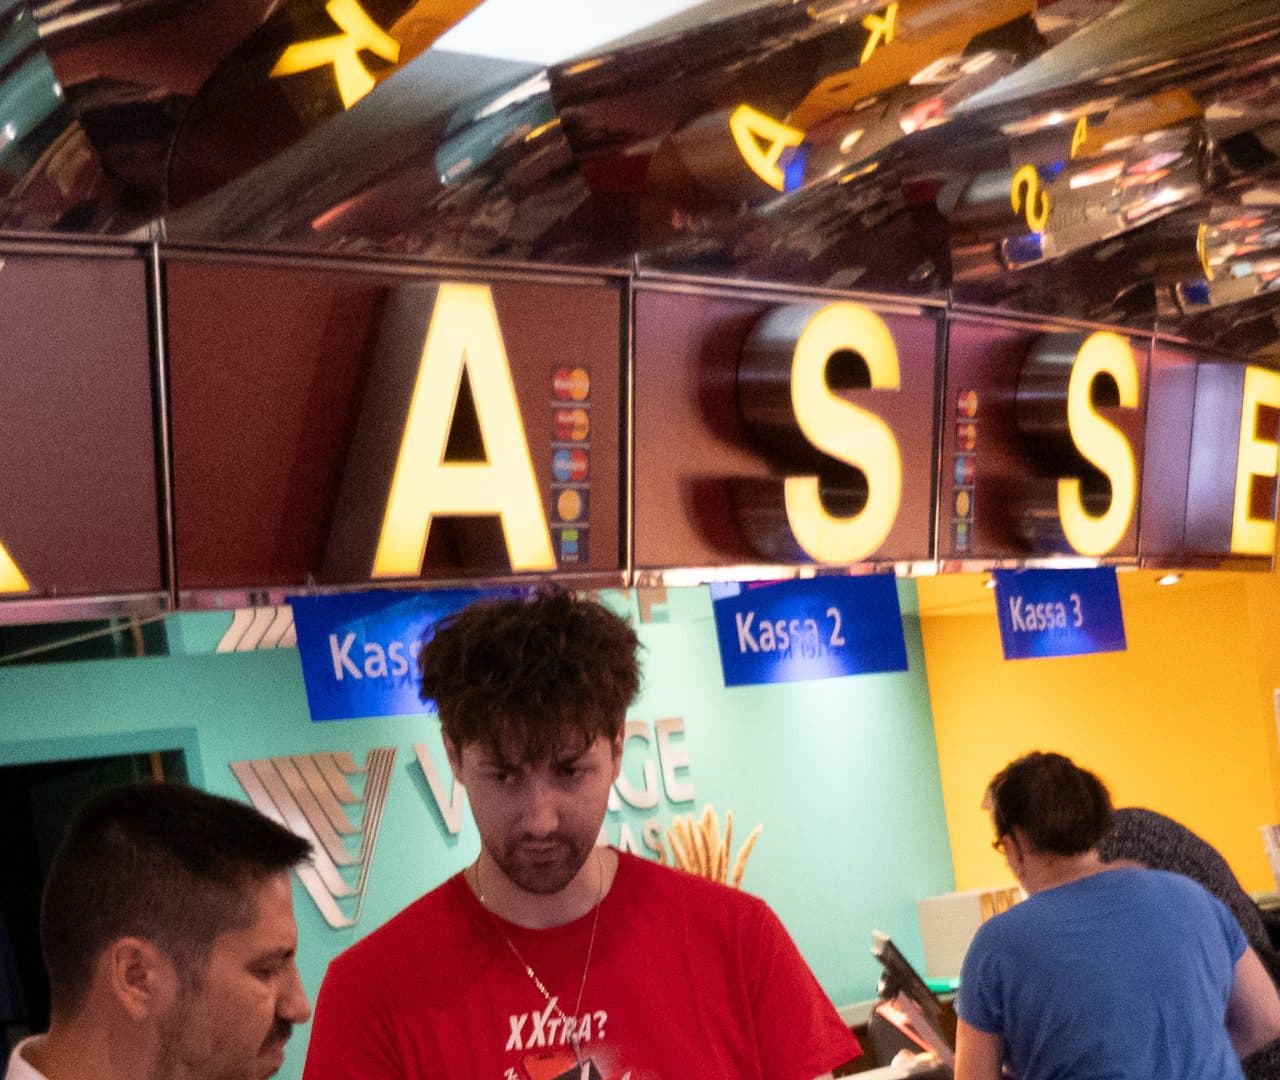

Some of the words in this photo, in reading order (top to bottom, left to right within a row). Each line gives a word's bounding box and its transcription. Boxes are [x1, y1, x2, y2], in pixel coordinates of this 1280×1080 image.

[735, 610, 819, 655] Kassa
[826, 606, 846, 646] 2
[1009, 596, 1066, 632] Kassa
[1069, 593, 1083, 627] 3
